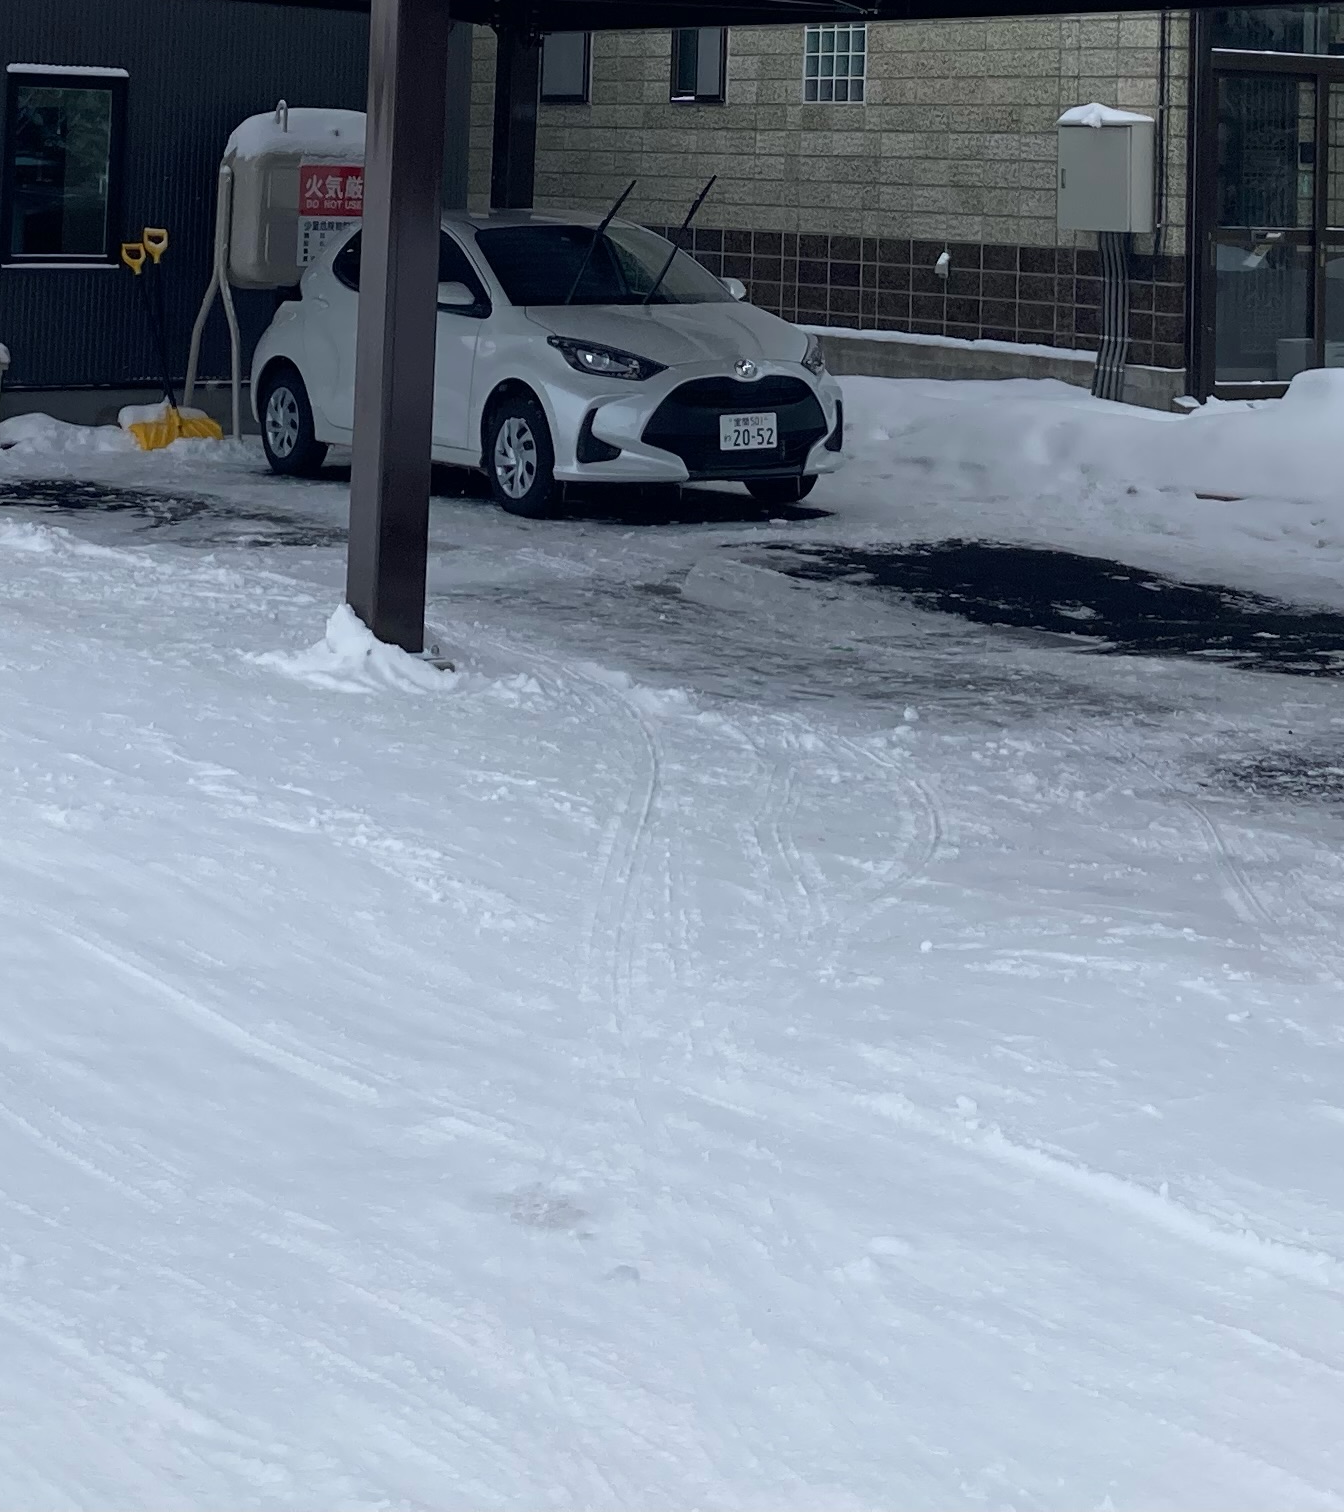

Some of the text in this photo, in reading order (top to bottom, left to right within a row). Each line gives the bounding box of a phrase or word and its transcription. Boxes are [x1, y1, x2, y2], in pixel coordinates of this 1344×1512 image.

[306, 199, 320, 209] DO
[323, 199, 344, 209] NOT
[733, 427, 774, 447] 20-52
